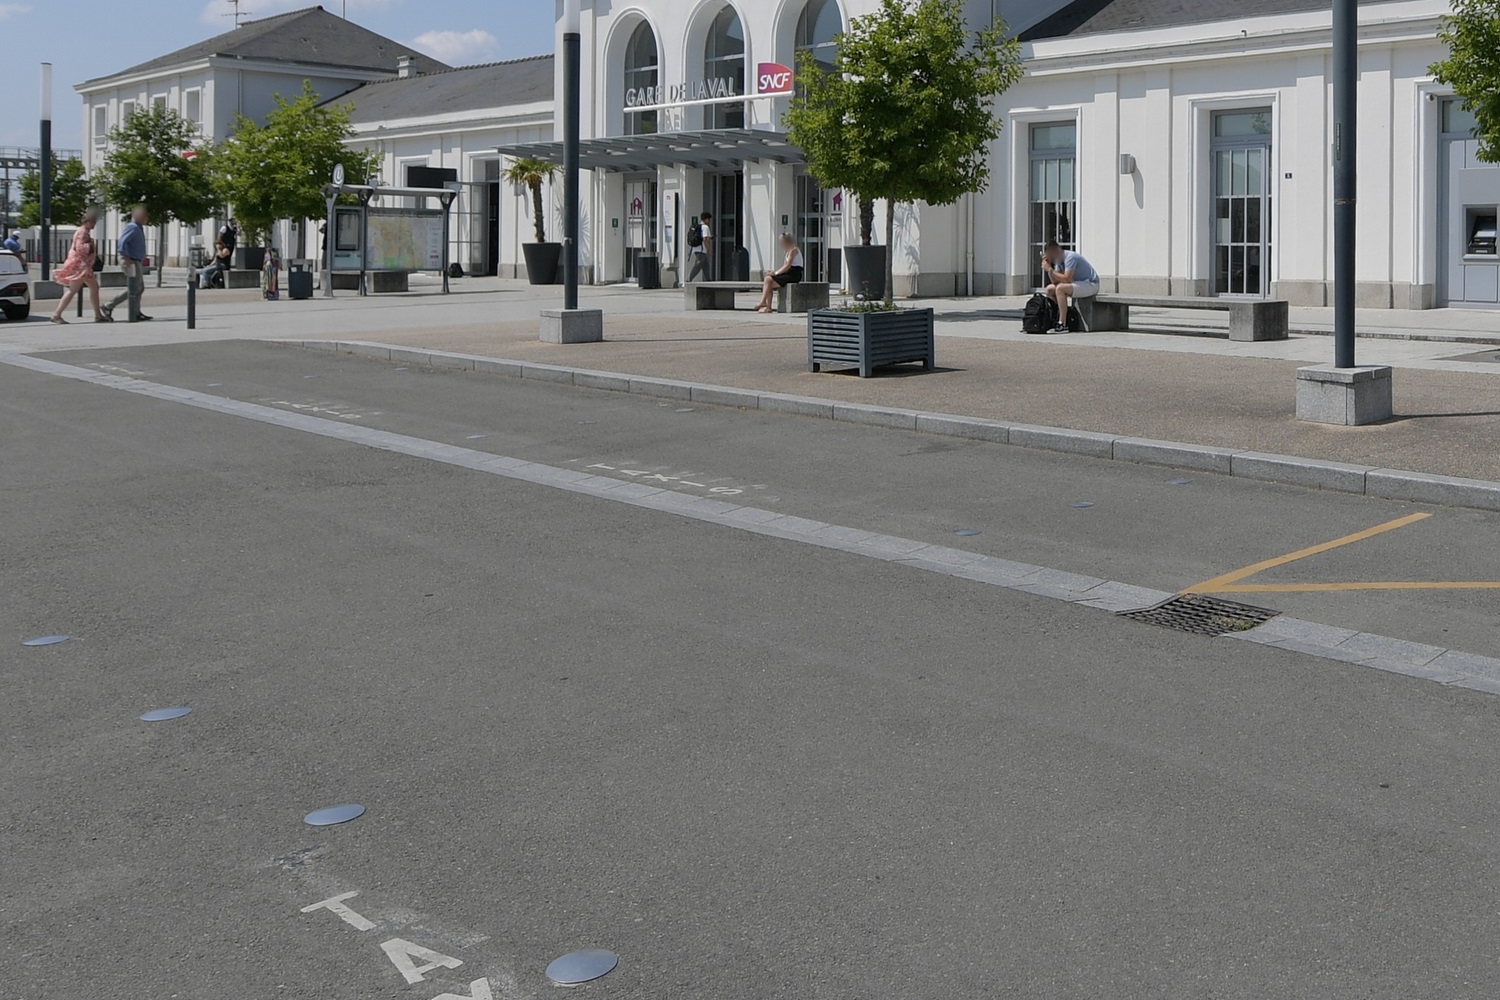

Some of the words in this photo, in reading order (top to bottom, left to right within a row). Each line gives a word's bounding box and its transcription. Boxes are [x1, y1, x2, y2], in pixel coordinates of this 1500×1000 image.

[625, 85, 662, 107] GARE
[670, 83, 686, 103] DE
[691, 76, 737, 99] LAVAL
[758, 72, 791, 90] SNCF
[586, 462, 743, 496] TAXIS
